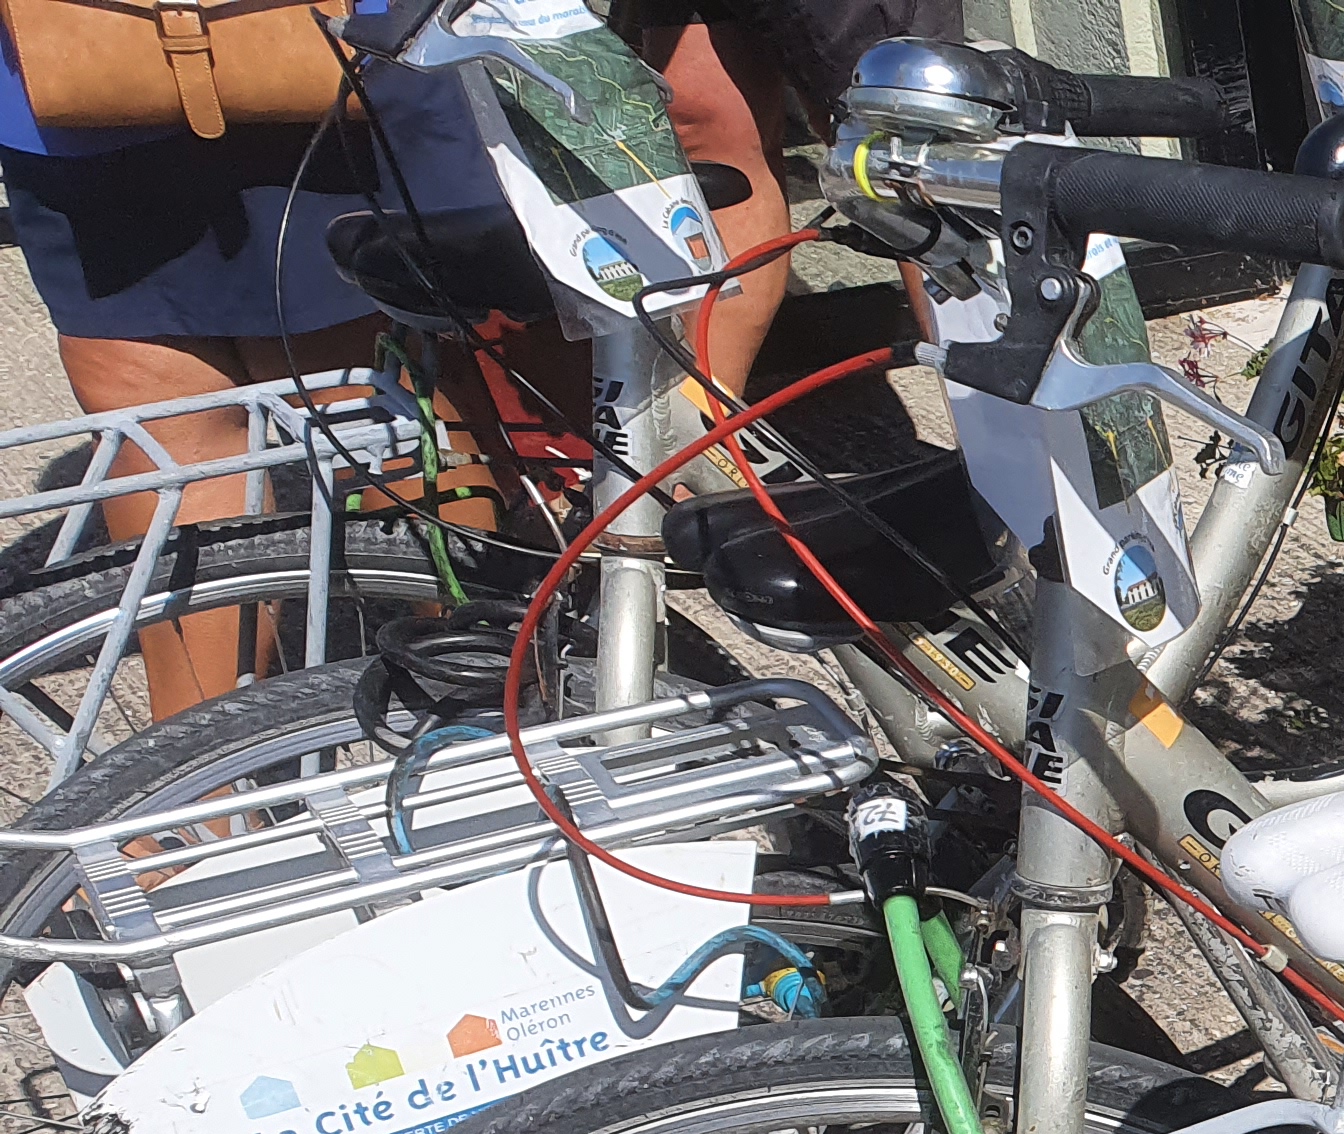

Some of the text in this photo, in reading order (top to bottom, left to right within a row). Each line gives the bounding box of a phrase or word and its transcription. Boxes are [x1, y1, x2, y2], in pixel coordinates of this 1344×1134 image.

[499, 983, 596, 1025] Marennes
[506, 1011, 572, 1042] Oléron
[407, 1079, 455, 1110] de
[466, 1031, 610, 1092] l'Huître
